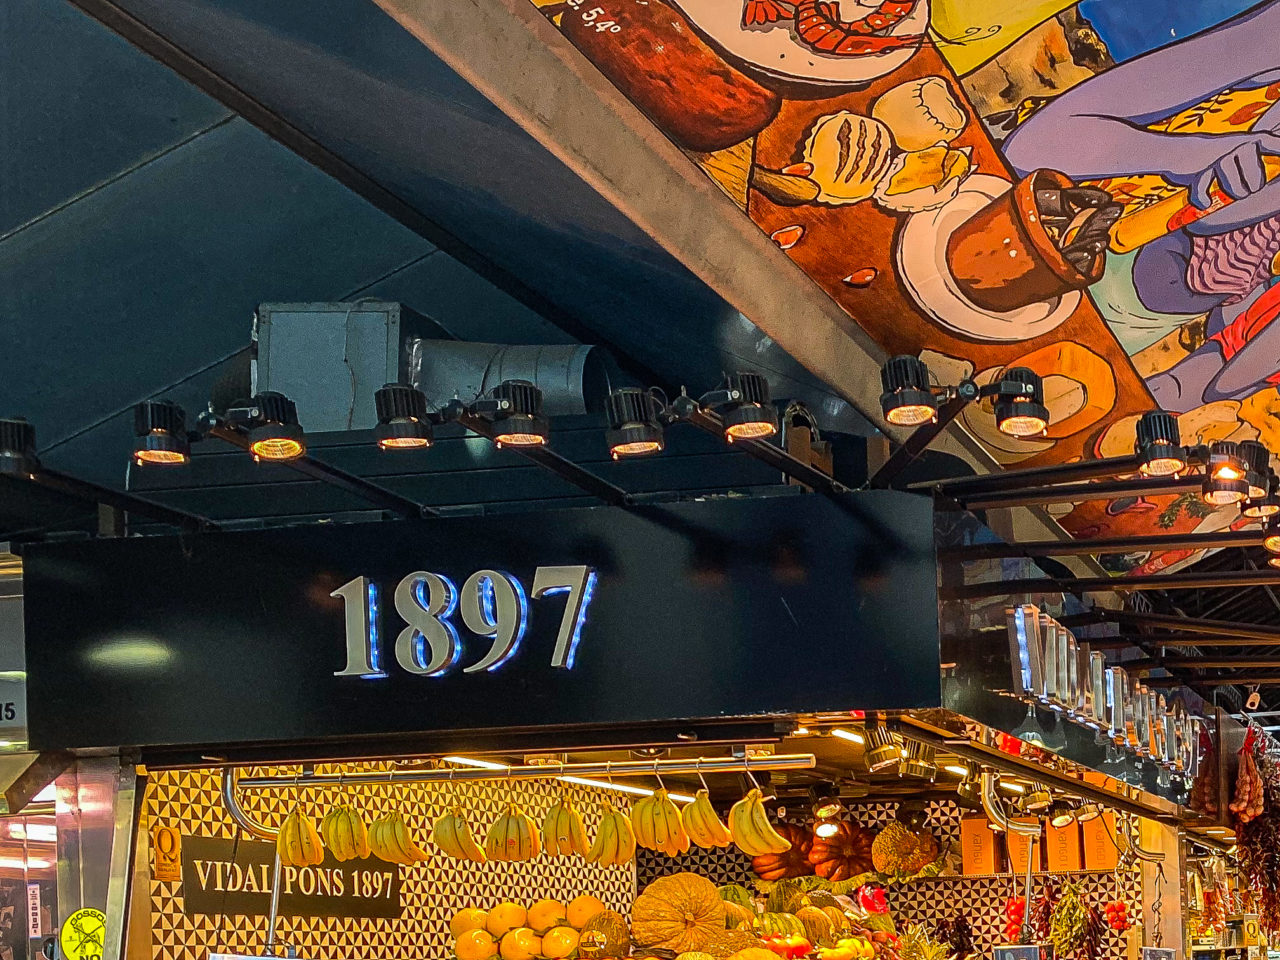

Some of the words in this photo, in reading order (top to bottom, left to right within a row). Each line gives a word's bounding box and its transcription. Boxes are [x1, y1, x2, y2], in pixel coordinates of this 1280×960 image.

[330, 565, 595, 678] 1897
[193, 860, 272, 893] VIDAL
[283, 866, 345, 898] PONS
[351, 869, 393, 899] 1897
[70, 909, 107, 927] GOSSO
